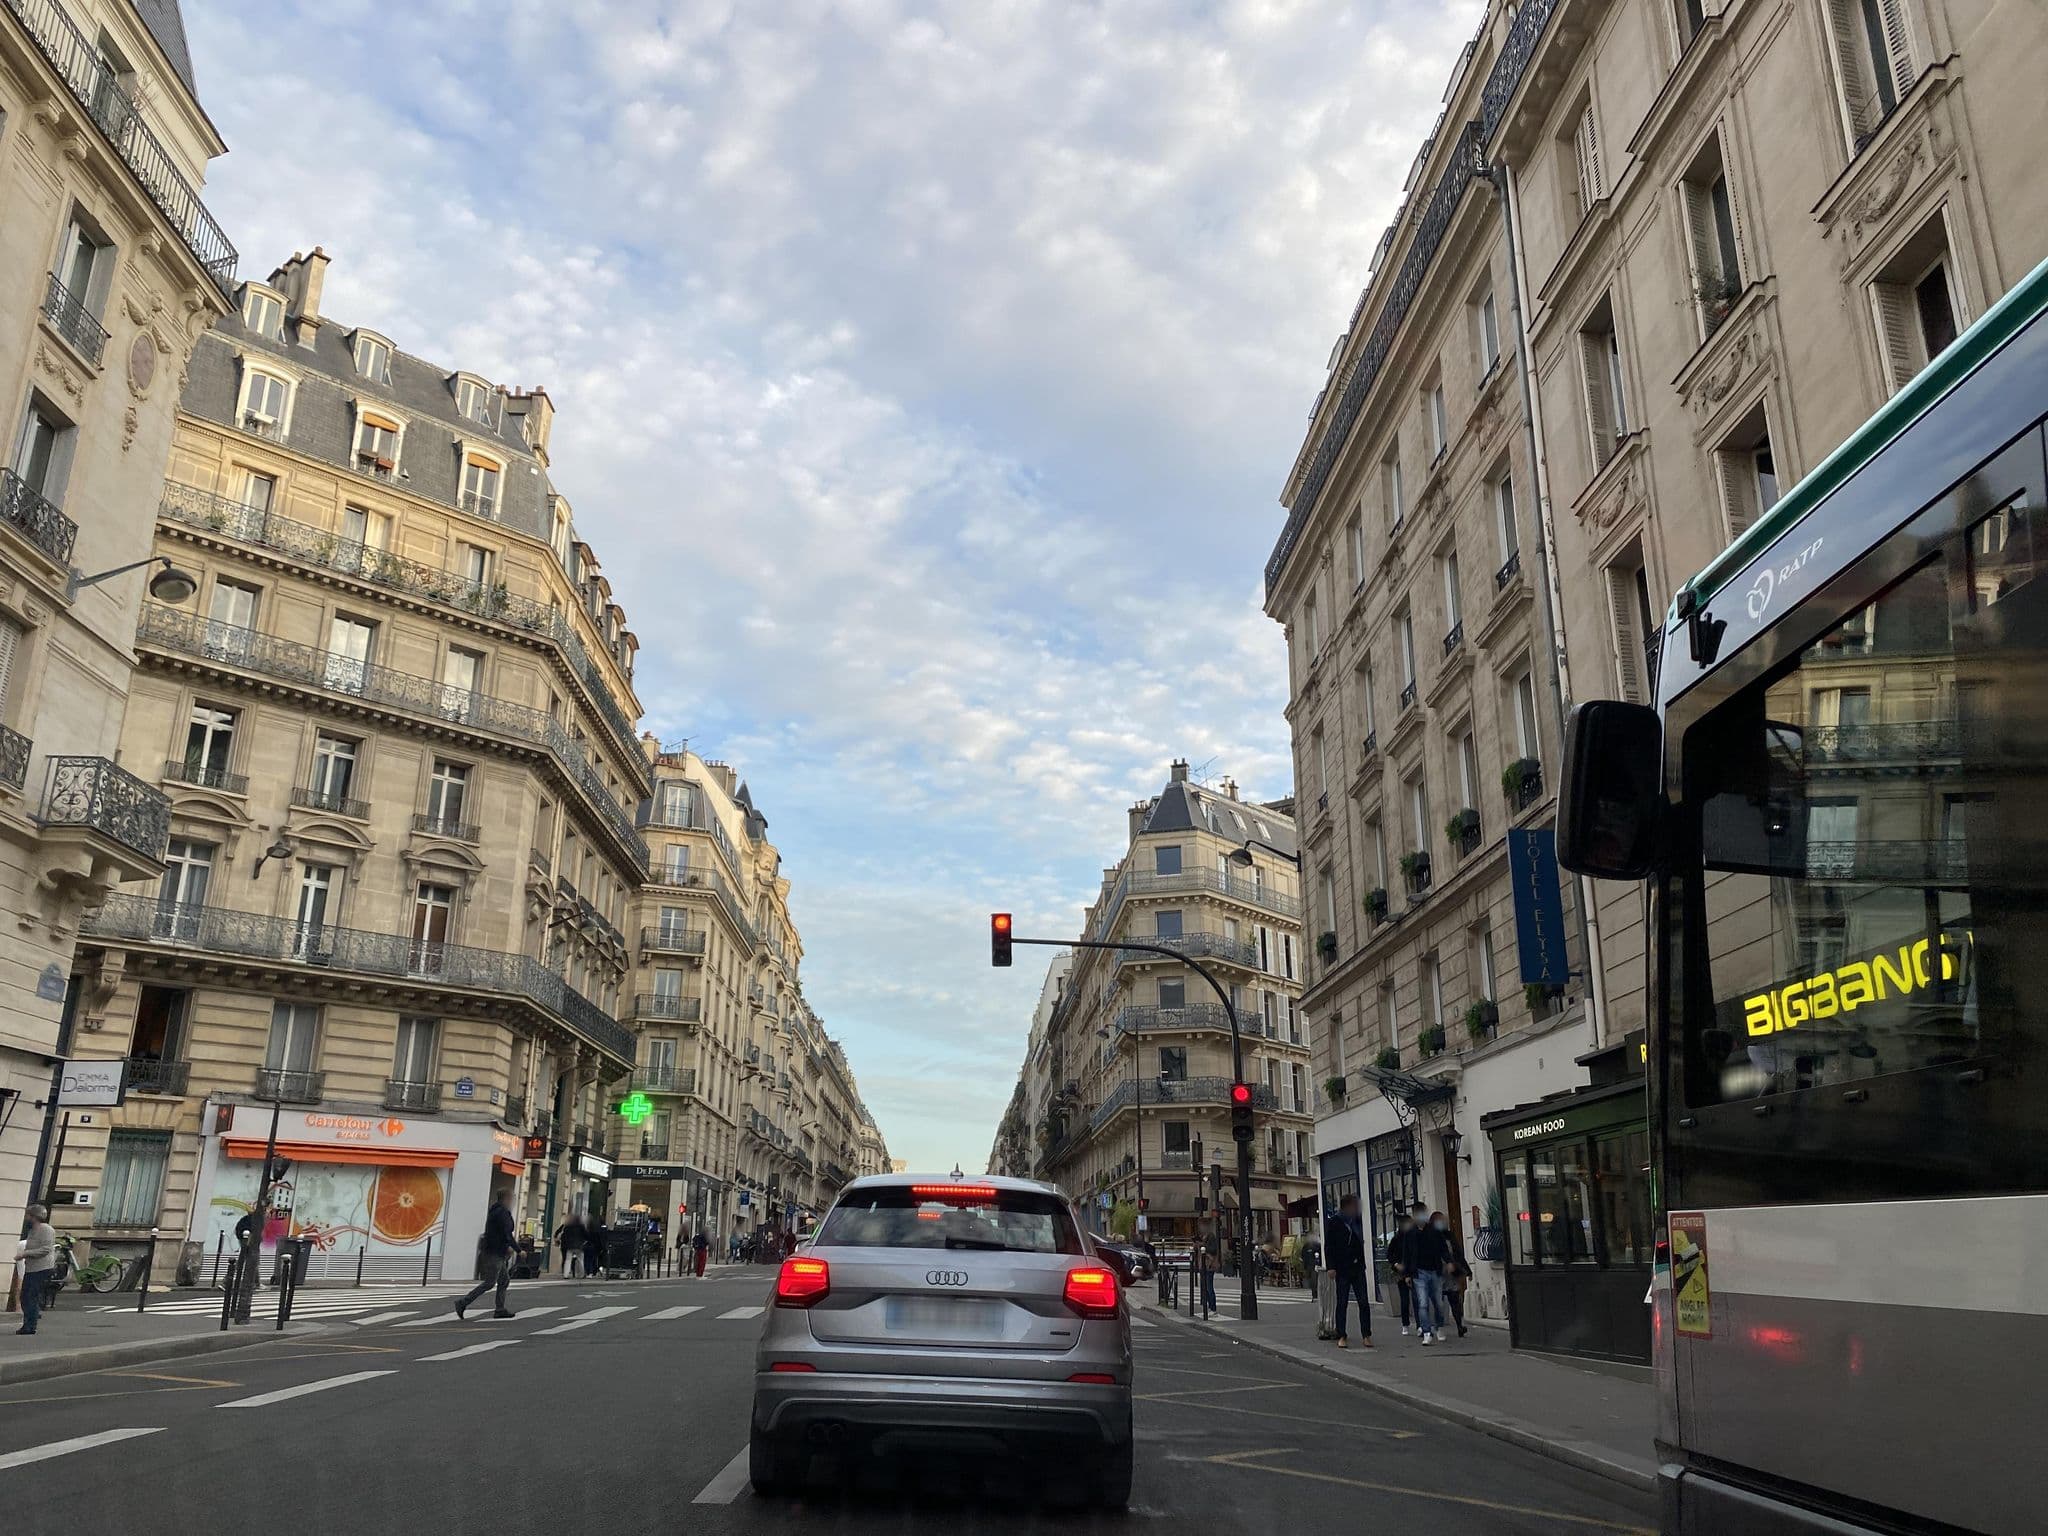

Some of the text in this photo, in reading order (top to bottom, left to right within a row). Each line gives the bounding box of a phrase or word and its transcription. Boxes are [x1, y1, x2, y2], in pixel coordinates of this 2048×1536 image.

[1778, 536, 1824, 586] RATP
[1528, 832, 1551, 979] HOTEL ELYSA
[62, 1076, 117, 1093] Delorme
[78, 1073, 109, 1082] EMMA
[305, 1112, 371, 1130] Carrefour
[1514, 1118, 1565, 1140] KOREAN FOOD
